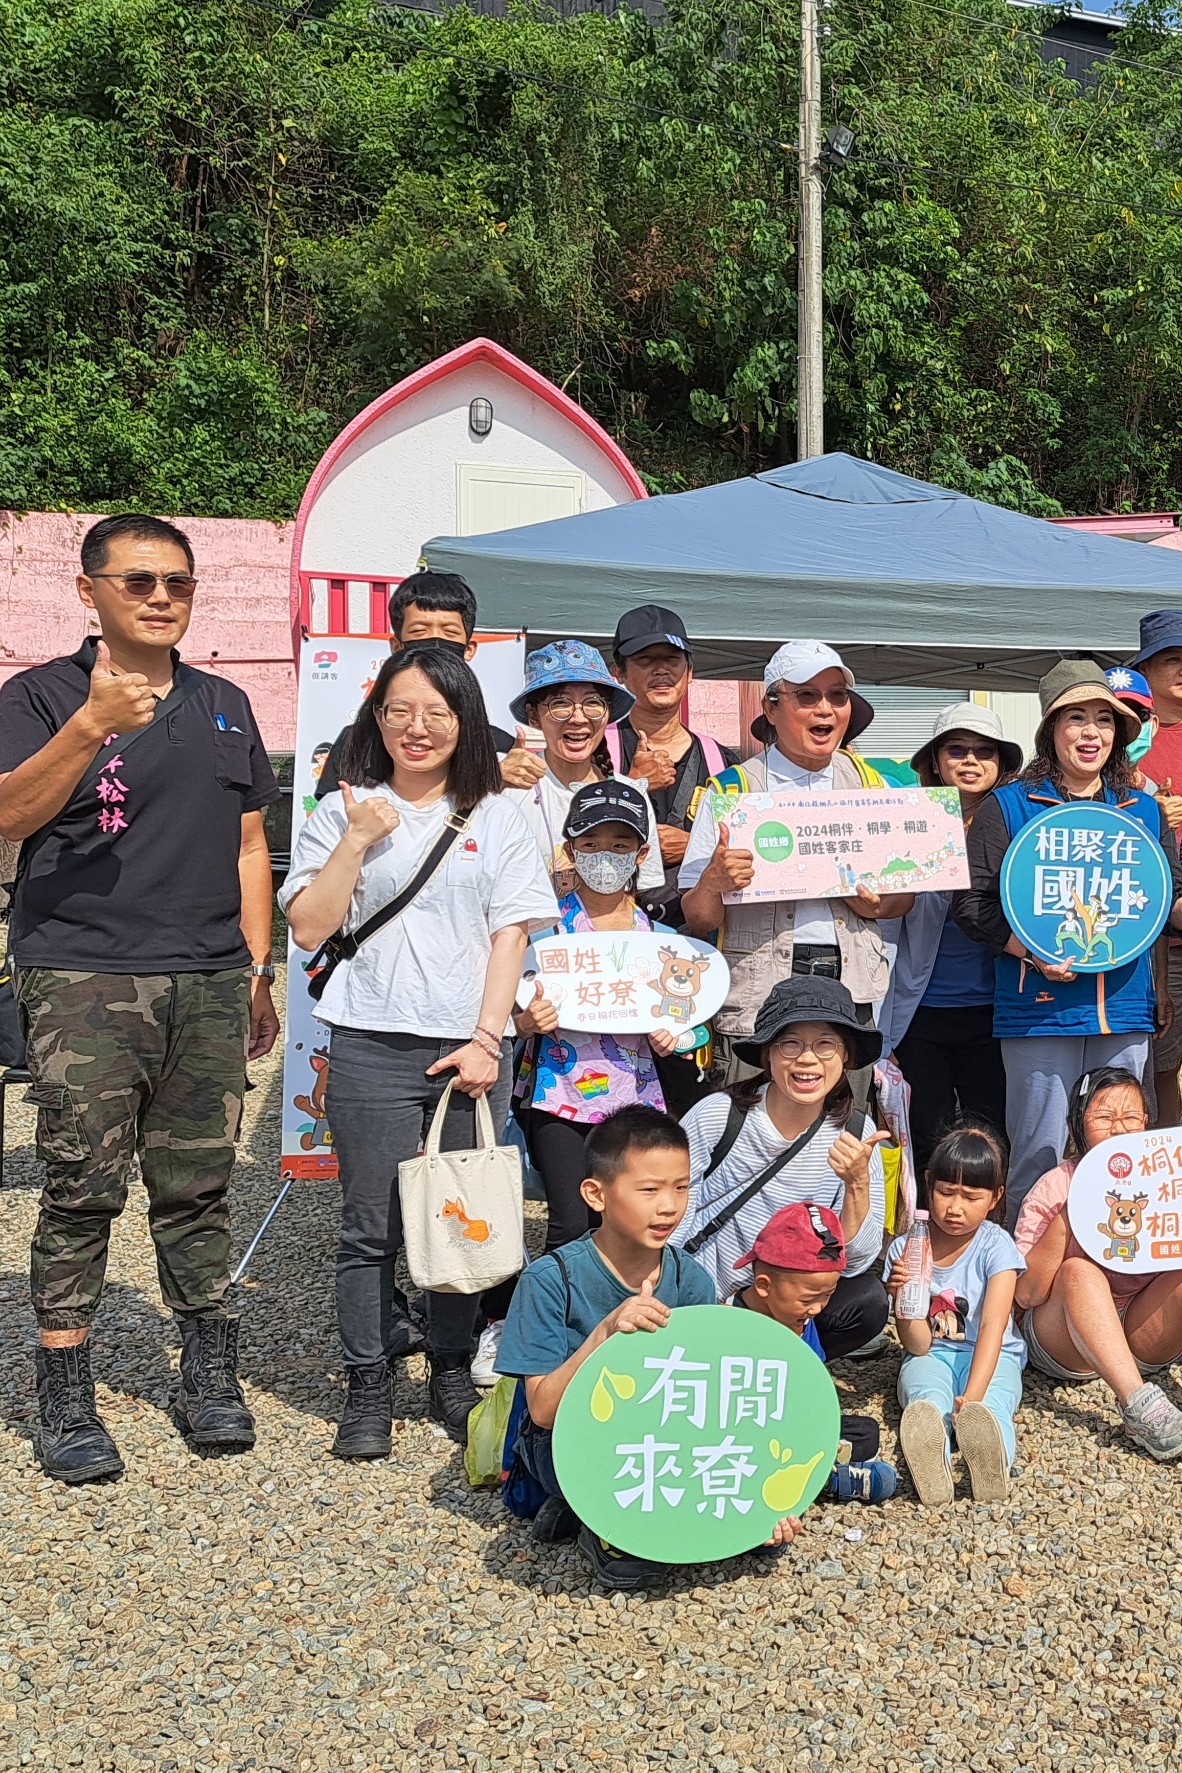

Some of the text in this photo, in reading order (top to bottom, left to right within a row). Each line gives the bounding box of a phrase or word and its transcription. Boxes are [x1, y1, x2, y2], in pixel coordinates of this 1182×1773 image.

[758, 836, 789, 849] 國姓鄉
[798, 840, 864, 856] 國姓客家庄
[1034, 826, 1143, 865] 相聚在
[1033, 864, 1142, 920] 國姓
[539, 946, 604, 975] 國姓
[1144, 1135, 1173, 1148] 2024
[636, 1345, 788, 1430] 有閒
[1141, 1388, 1162, 1408] LOTTO
